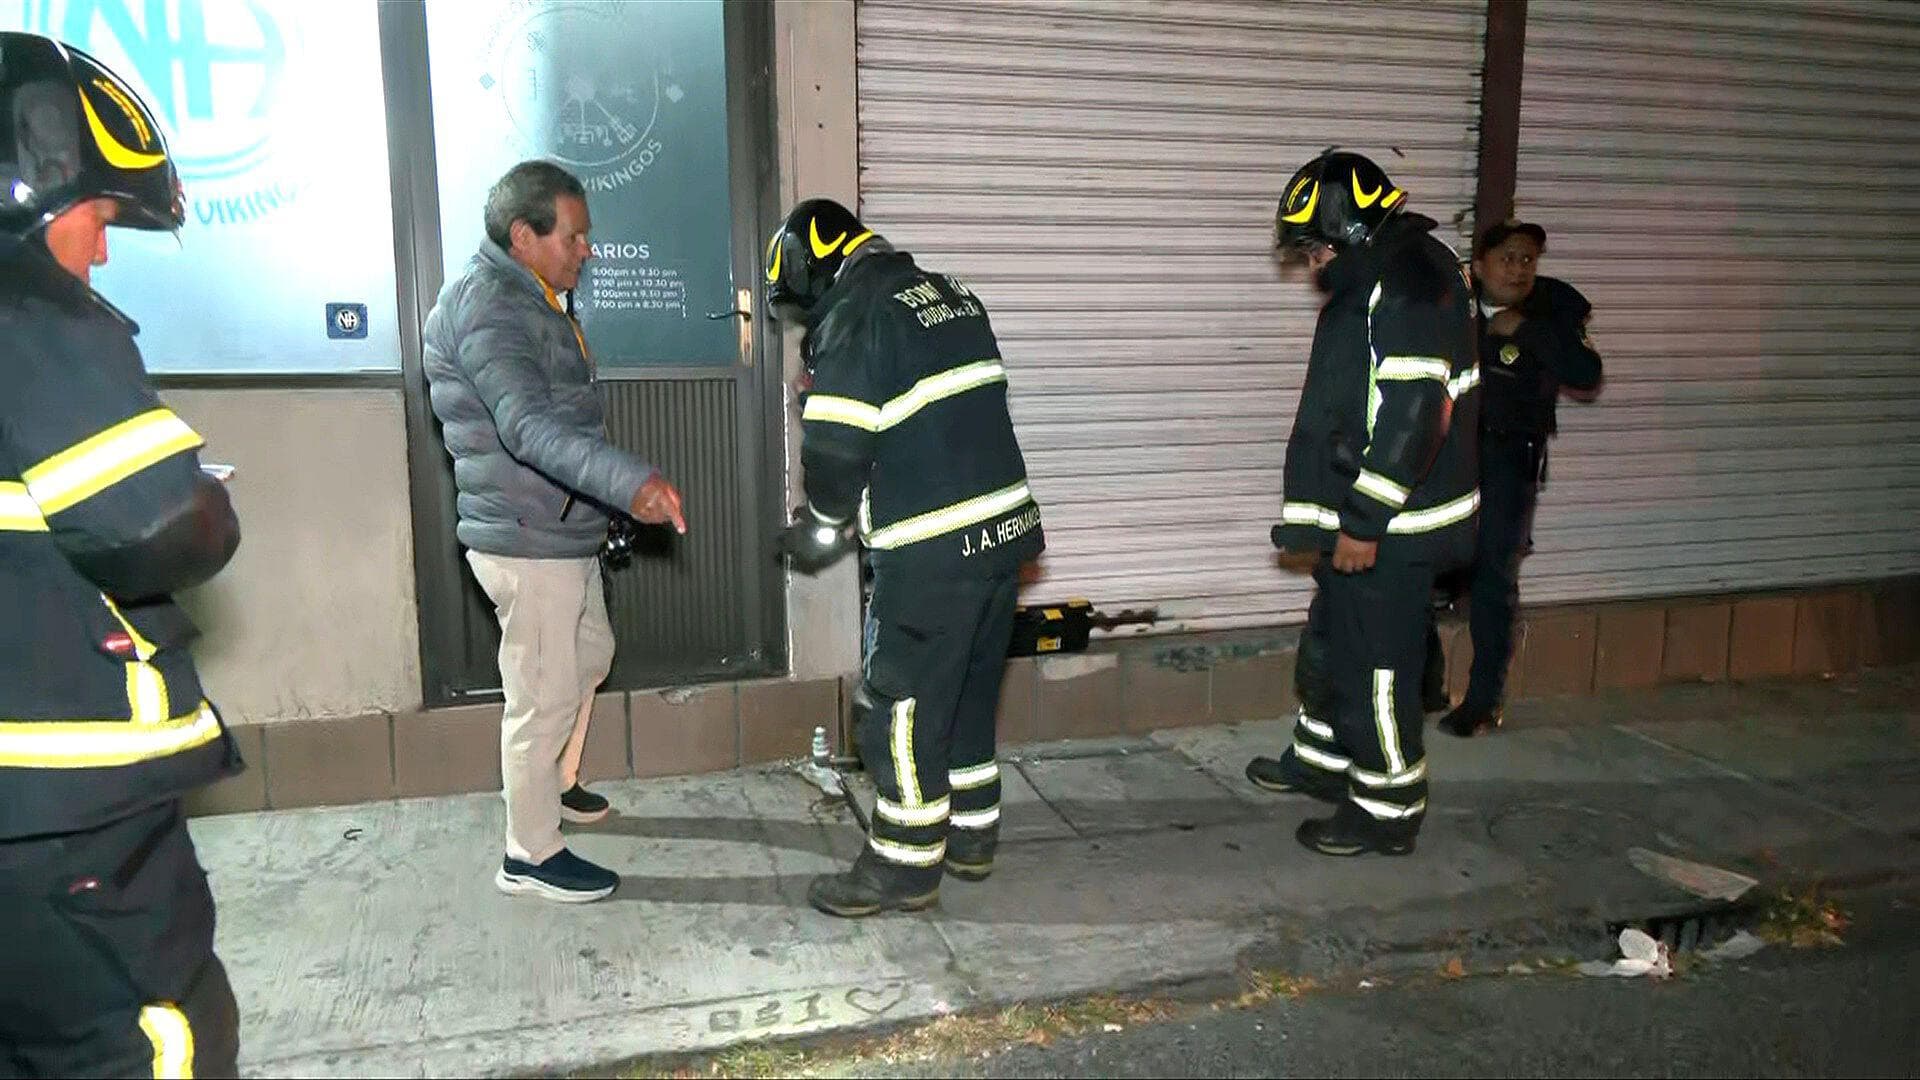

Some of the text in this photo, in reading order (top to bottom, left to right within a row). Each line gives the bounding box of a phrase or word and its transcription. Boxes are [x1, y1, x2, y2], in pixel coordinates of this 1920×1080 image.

[582, 139, 662, 192] VIKINGOS
[591, 243, 650, 259] ARIOS
[917, 303, 955, 328] CIUDAD
[962, 534, 976, 556] J.
[981, 528, 996, 551] A.
